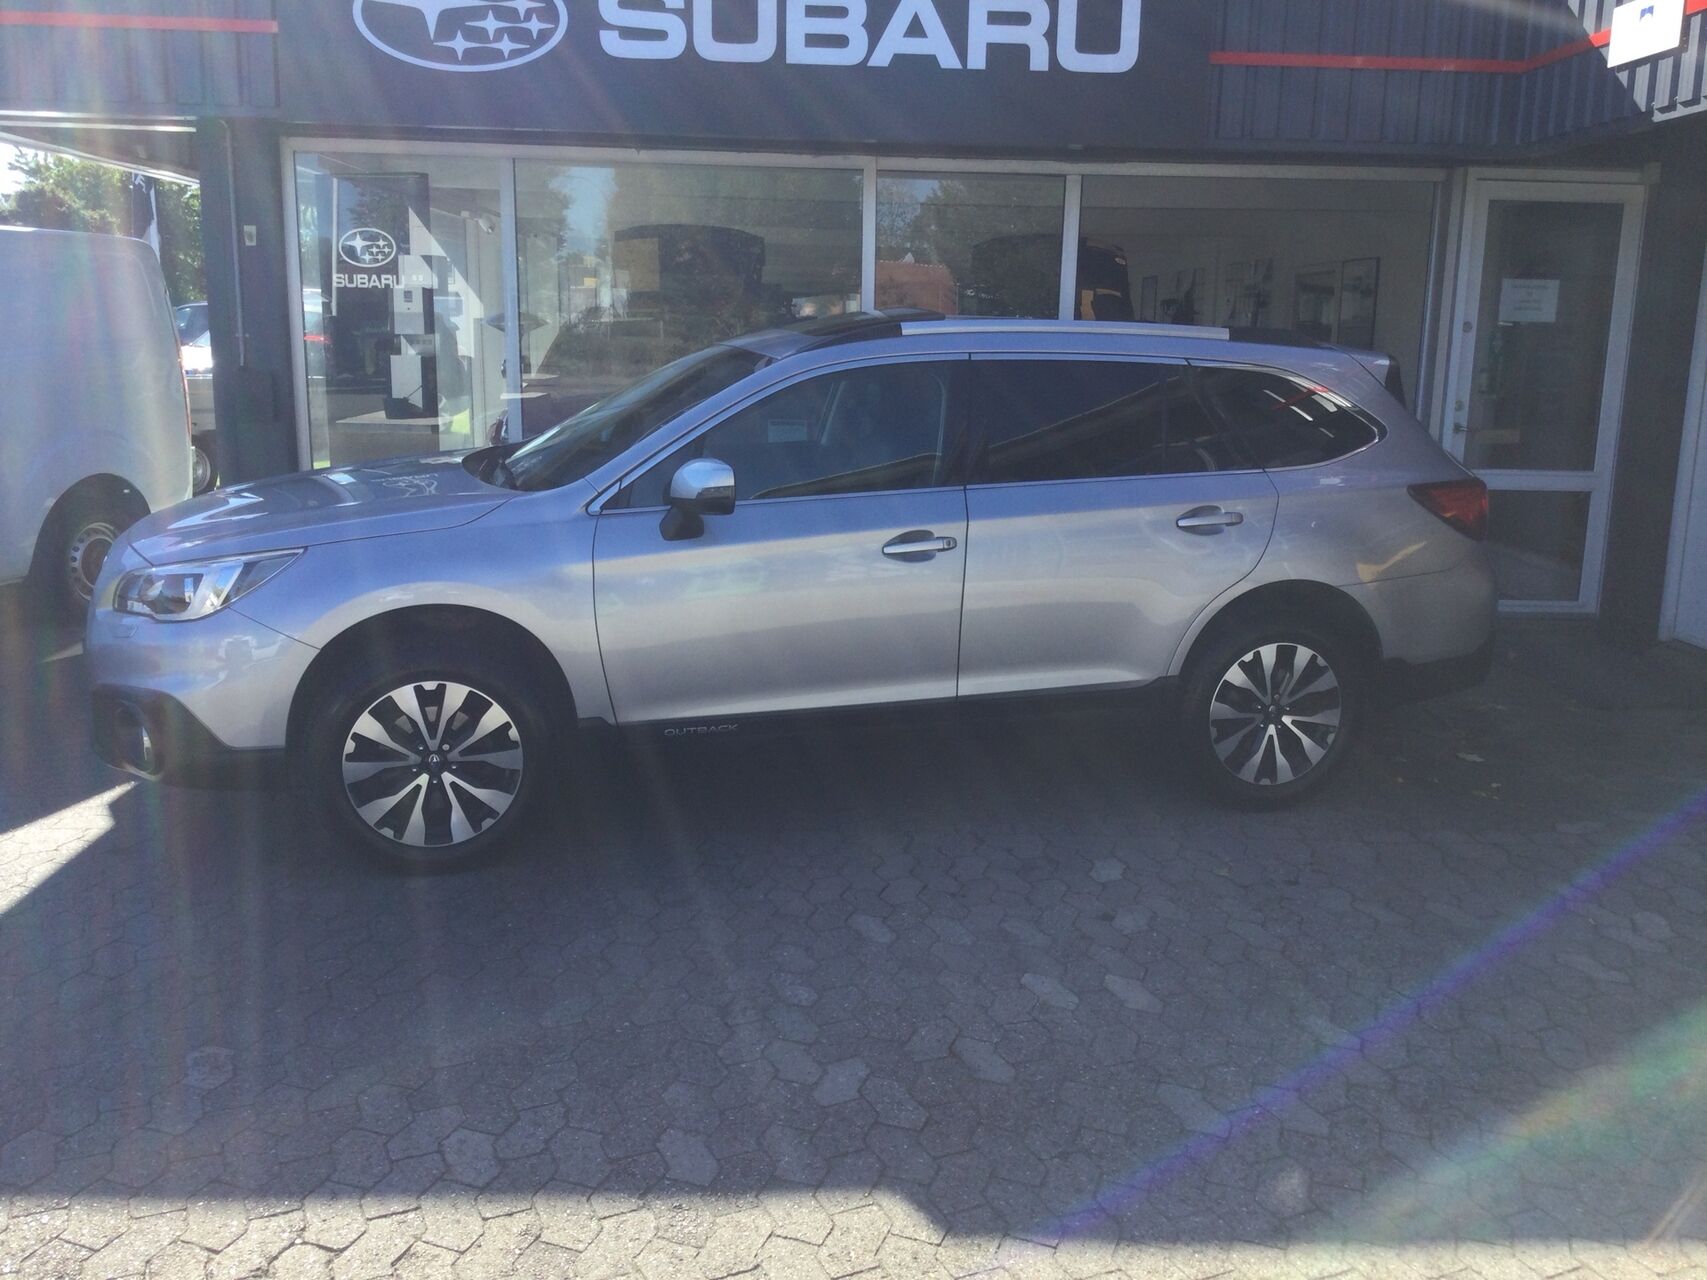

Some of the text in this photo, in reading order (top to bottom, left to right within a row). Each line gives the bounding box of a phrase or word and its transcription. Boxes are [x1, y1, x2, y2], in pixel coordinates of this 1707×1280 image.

[598, 0, 1141, 74] SUBARU
[334, 273, 405, 289] SUBARU
[664, 723, 739, 736] OUTBACK
